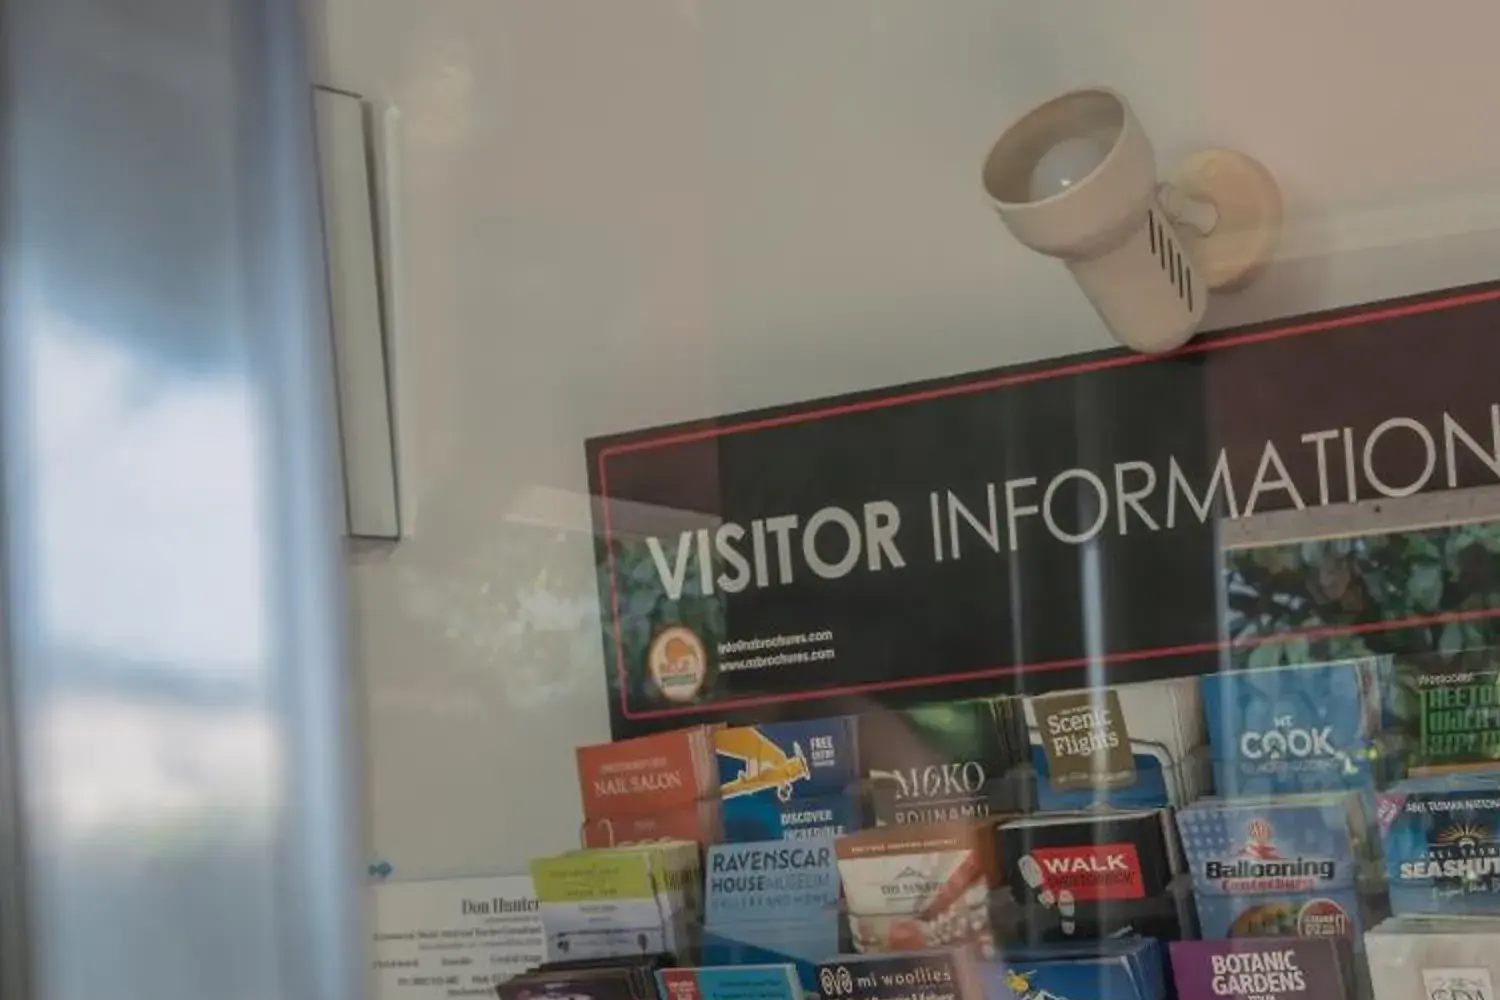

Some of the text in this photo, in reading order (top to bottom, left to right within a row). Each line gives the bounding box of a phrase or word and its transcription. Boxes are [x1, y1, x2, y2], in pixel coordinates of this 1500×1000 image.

[647, 500, 904, 600] VISITOR
[1047, 705, 1111, 736] Scenic
[810, 737, 833, 749] FREE
[1054, 726, 1120, 757] Flights
[1241, 726, 1336, 760] COOK
[630, 771, 683, 791] SALON
[713, 848, 830, 872] RAVENSCAR
[1043, 853, 1128, 875] WALK
[1206, 857, 1335, 880] Ballooning
[712, 876, 765, 893] HOUSE
[1212, 950, 1298, 974] BOTANIC
[857, 963, 951, 988] mi woollies
[1212, 970, 1306, 995] GARDENS
